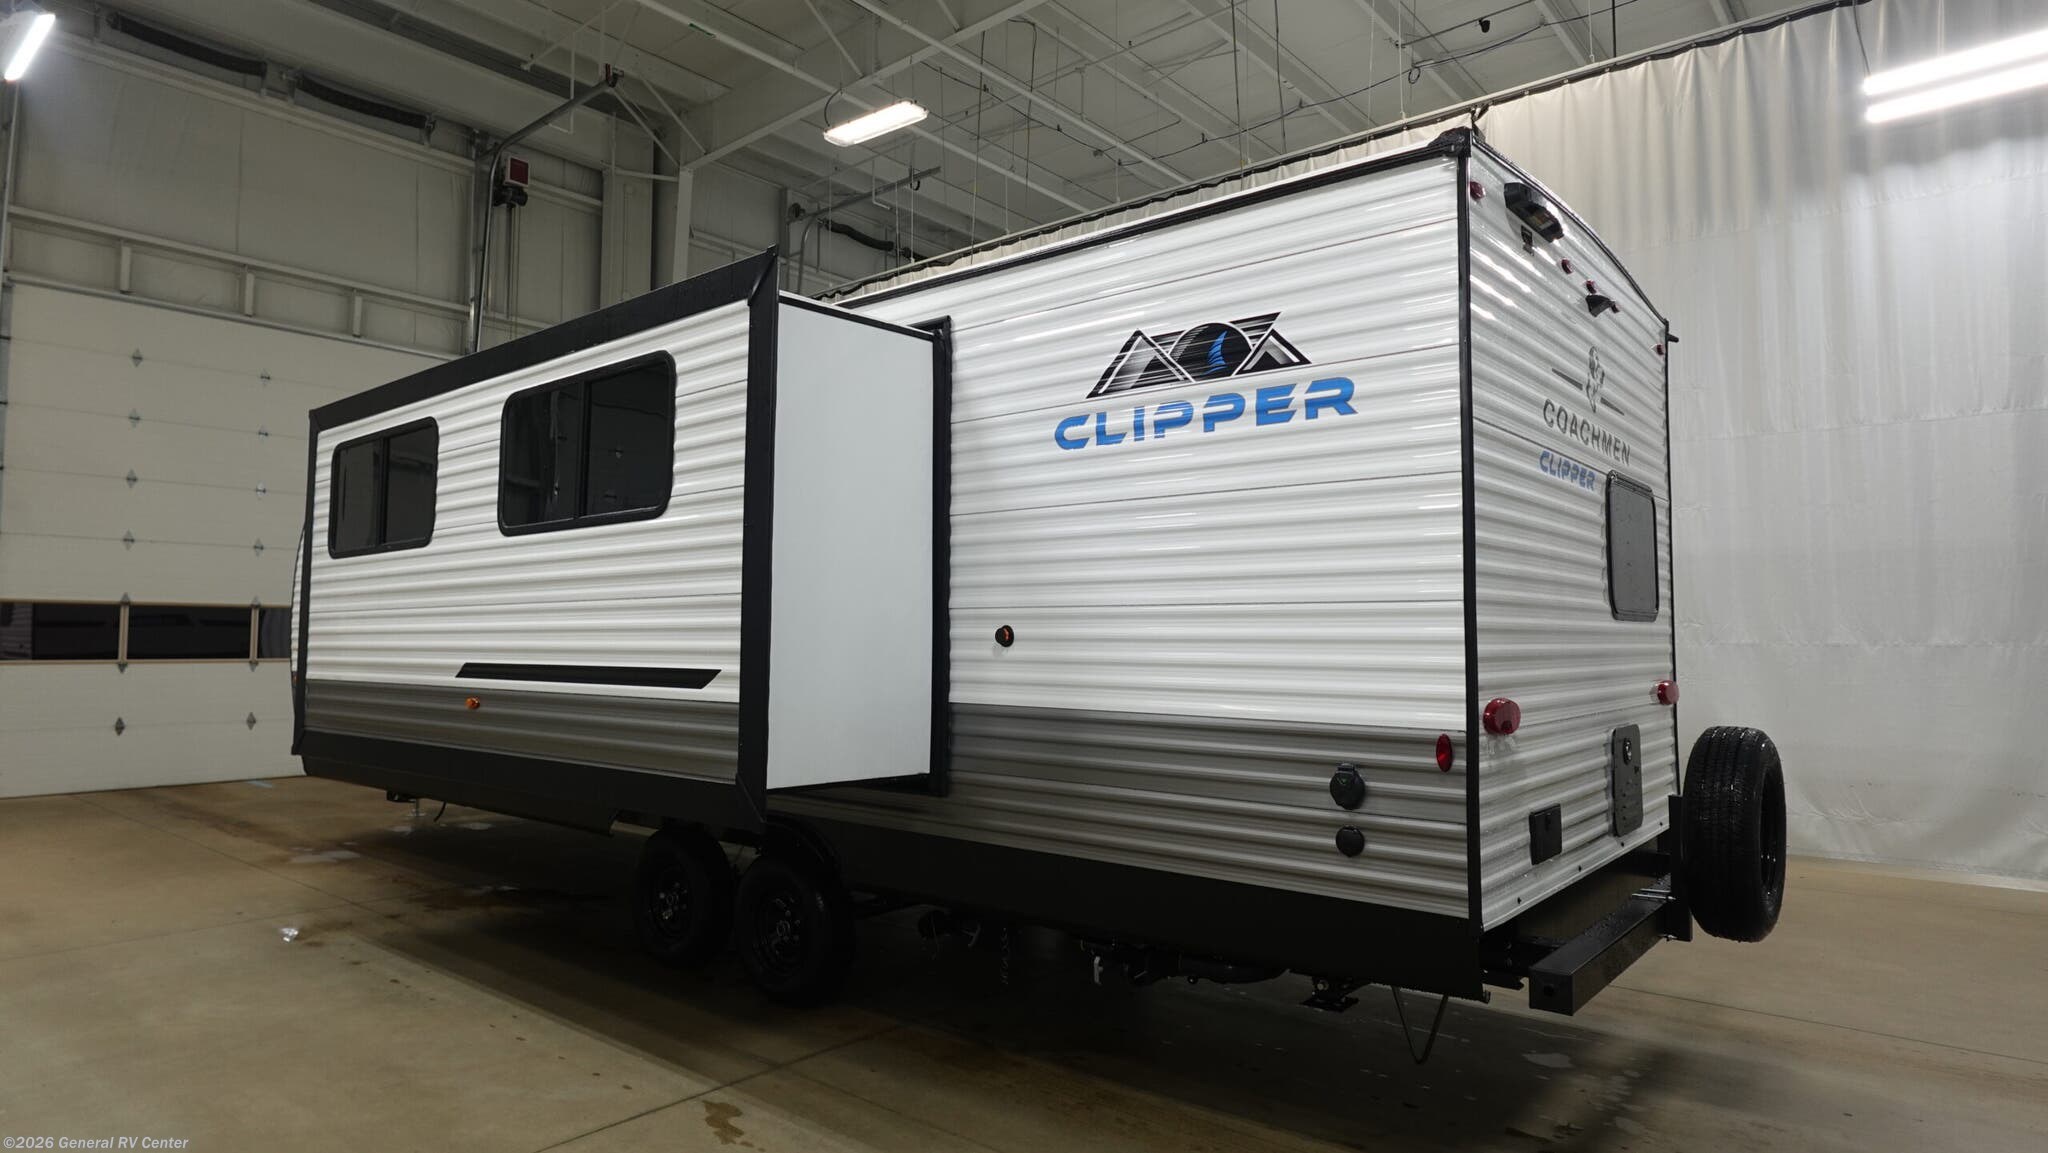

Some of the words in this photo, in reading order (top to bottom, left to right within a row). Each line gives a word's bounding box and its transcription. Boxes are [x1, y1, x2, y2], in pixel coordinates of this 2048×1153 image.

[1054, 376, 1357, 450] CLIPPER
[1543, 399, 1631, 466] COACHMEN
[1539, 450, 1597, 491] CLIPPER
